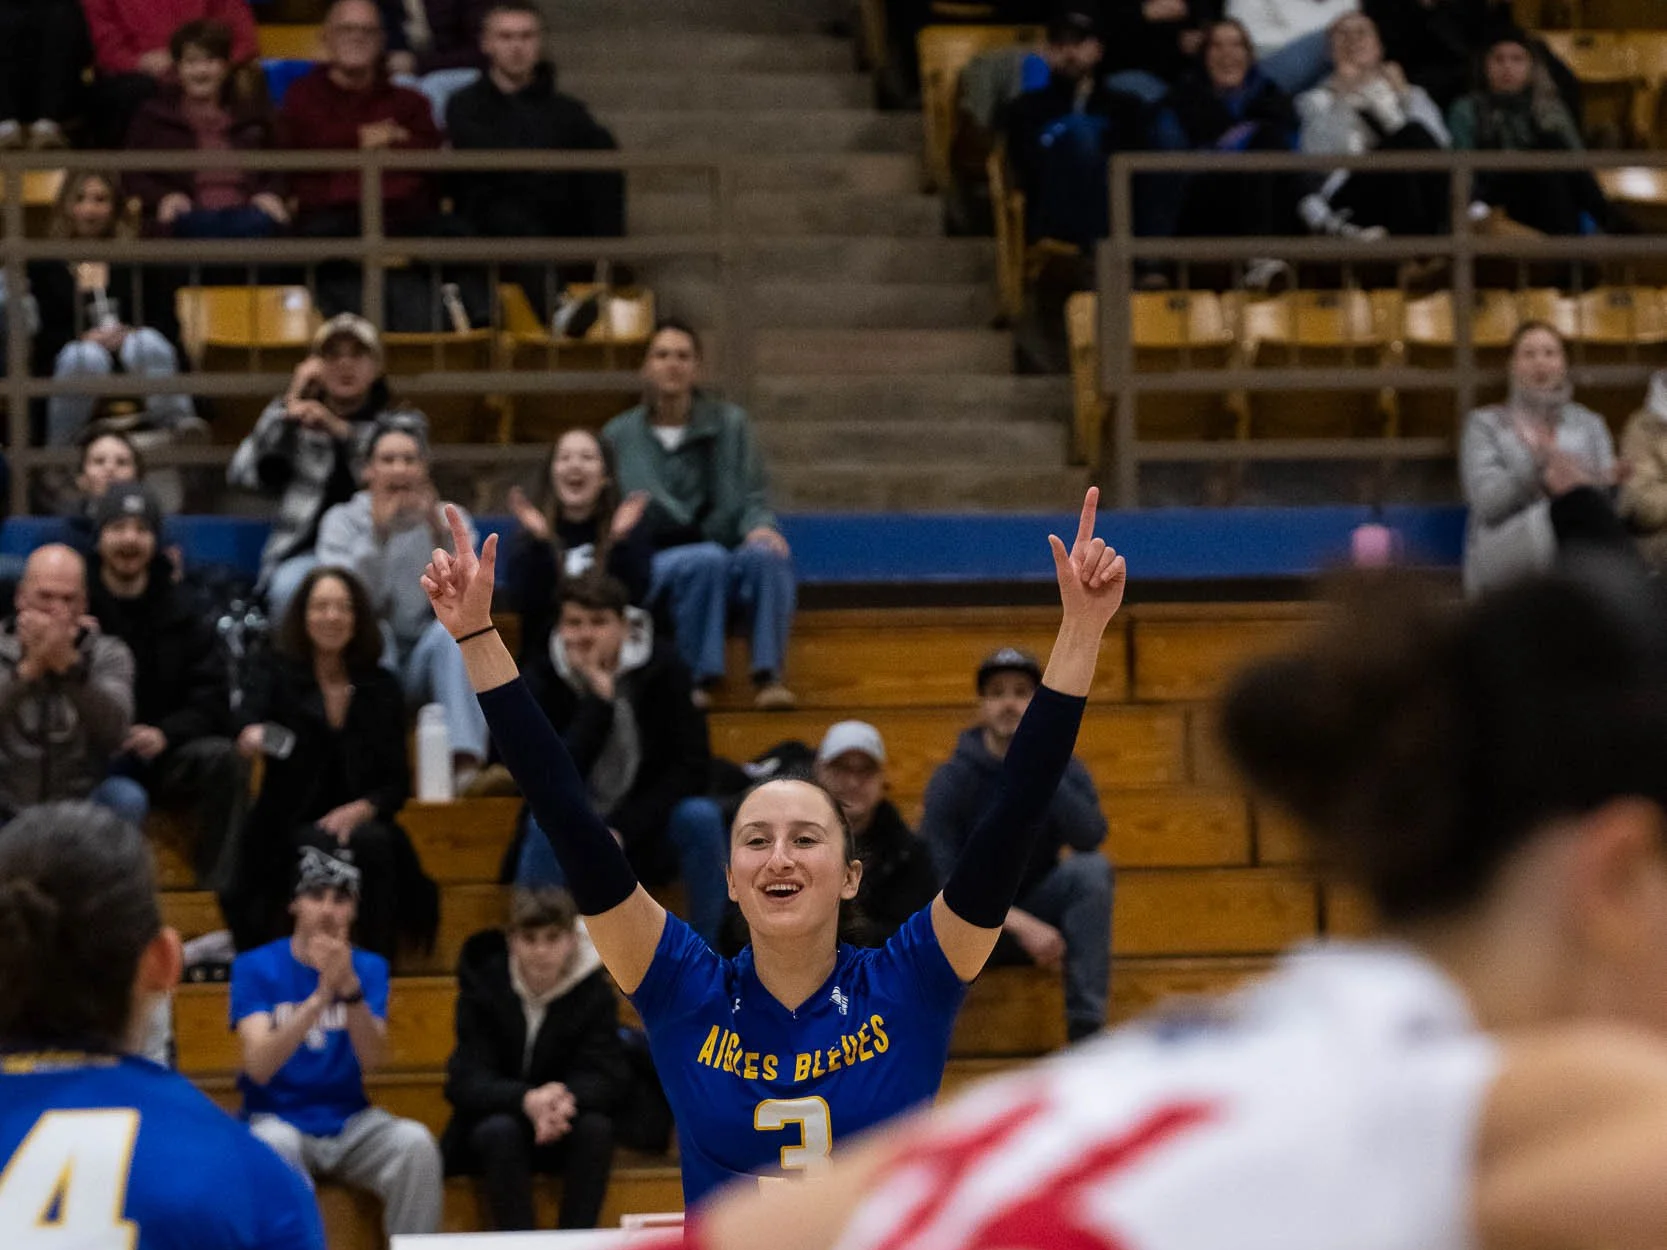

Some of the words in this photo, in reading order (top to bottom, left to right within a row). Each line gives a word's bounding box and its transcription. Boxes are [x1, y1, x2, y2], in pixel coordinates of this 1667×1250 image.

[697, 1024, 779, 1081] AIGLES
[794, 1014, 889, 1082] BLEUES
[754, 1095, 832, 1178] 3
